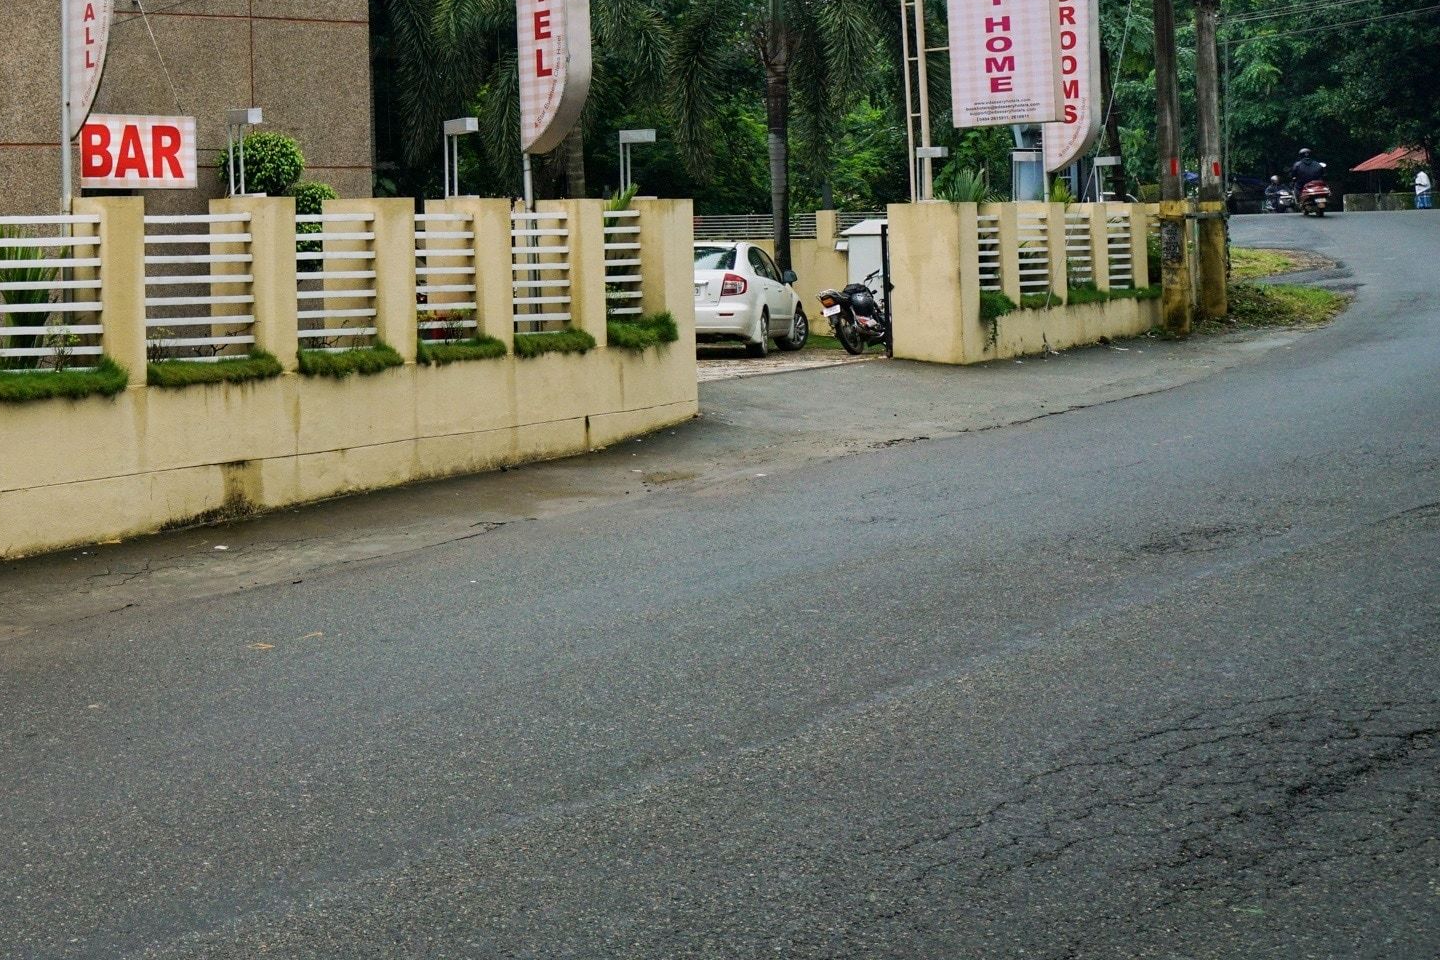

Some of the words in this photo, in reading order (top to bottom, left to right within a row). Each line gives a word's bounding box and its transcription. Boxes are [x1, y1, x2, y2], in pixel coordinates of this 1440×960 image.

[984, 15, 1016, 94] HOME
[1059, 6, 1079, 124] ROOMS
[81, 123, 185, 178] BAR
